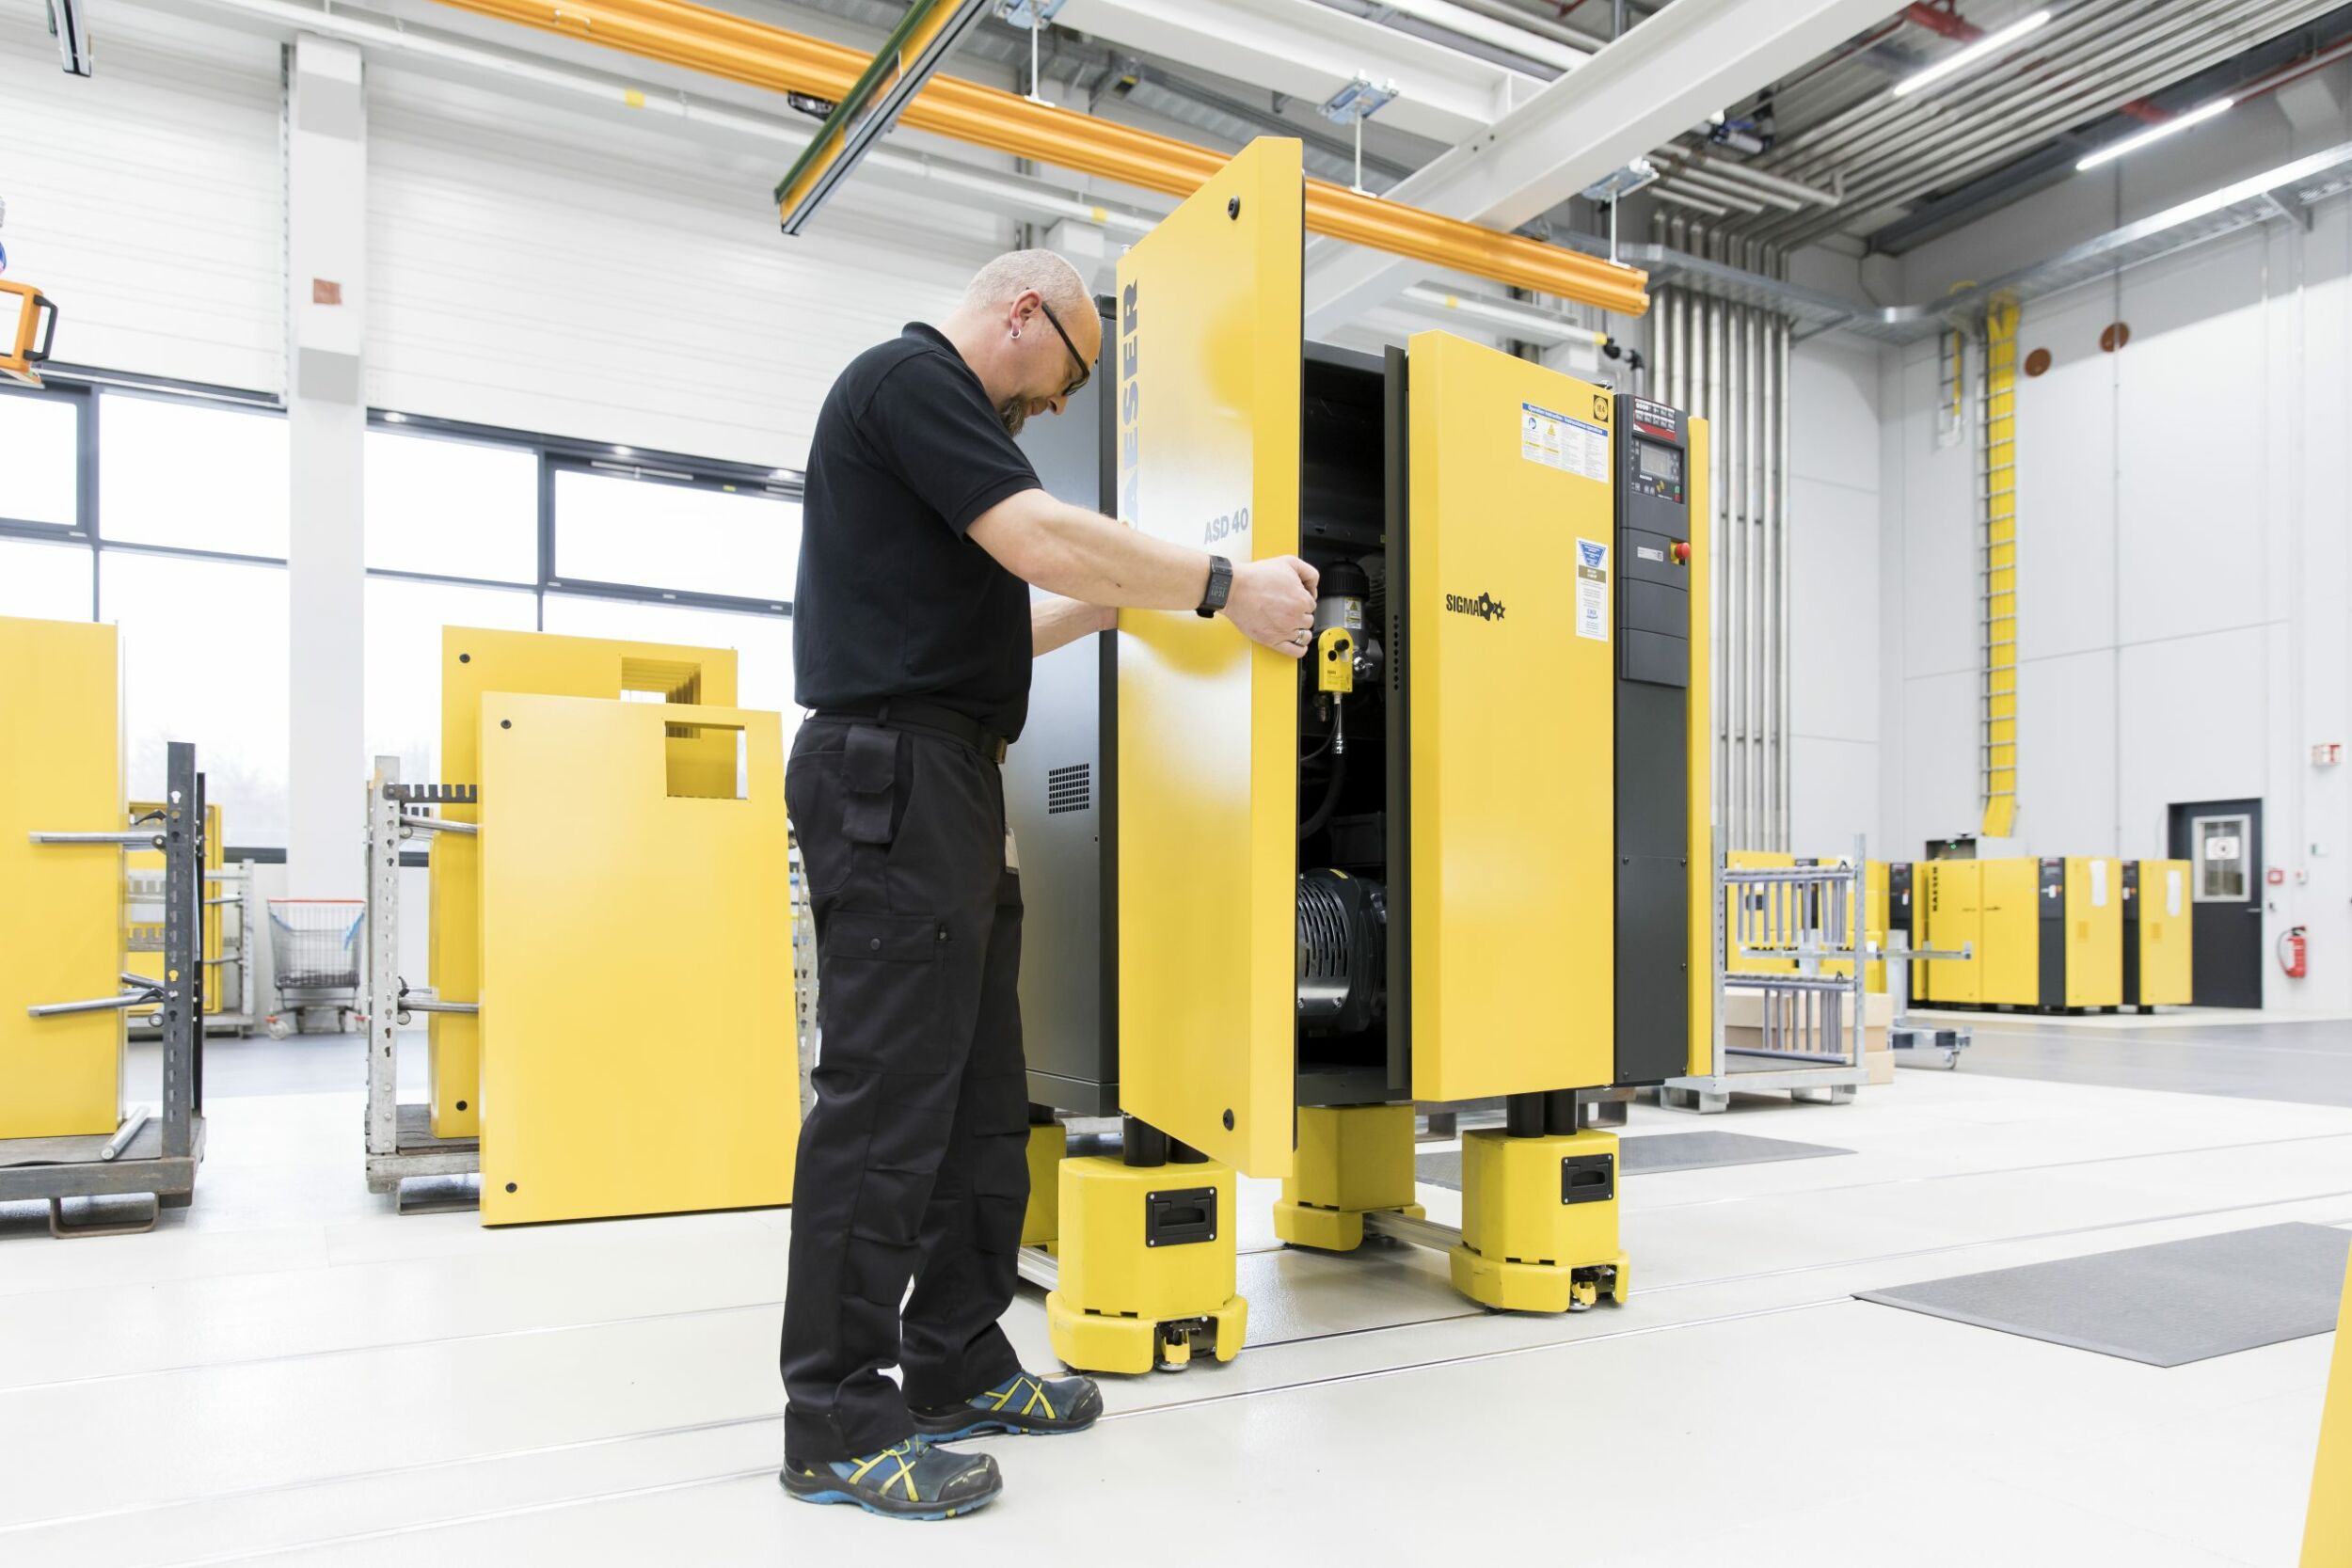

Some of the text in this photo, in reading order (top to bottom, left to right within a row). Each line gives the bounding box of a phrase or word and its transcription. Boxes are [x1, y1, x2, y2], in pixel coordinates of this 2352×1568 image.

[1122, 278, 1138, 530] AESER
[1204, 507, 1249, 545] ASD 40
[1446, 594, 1479, 617] SIGMA
